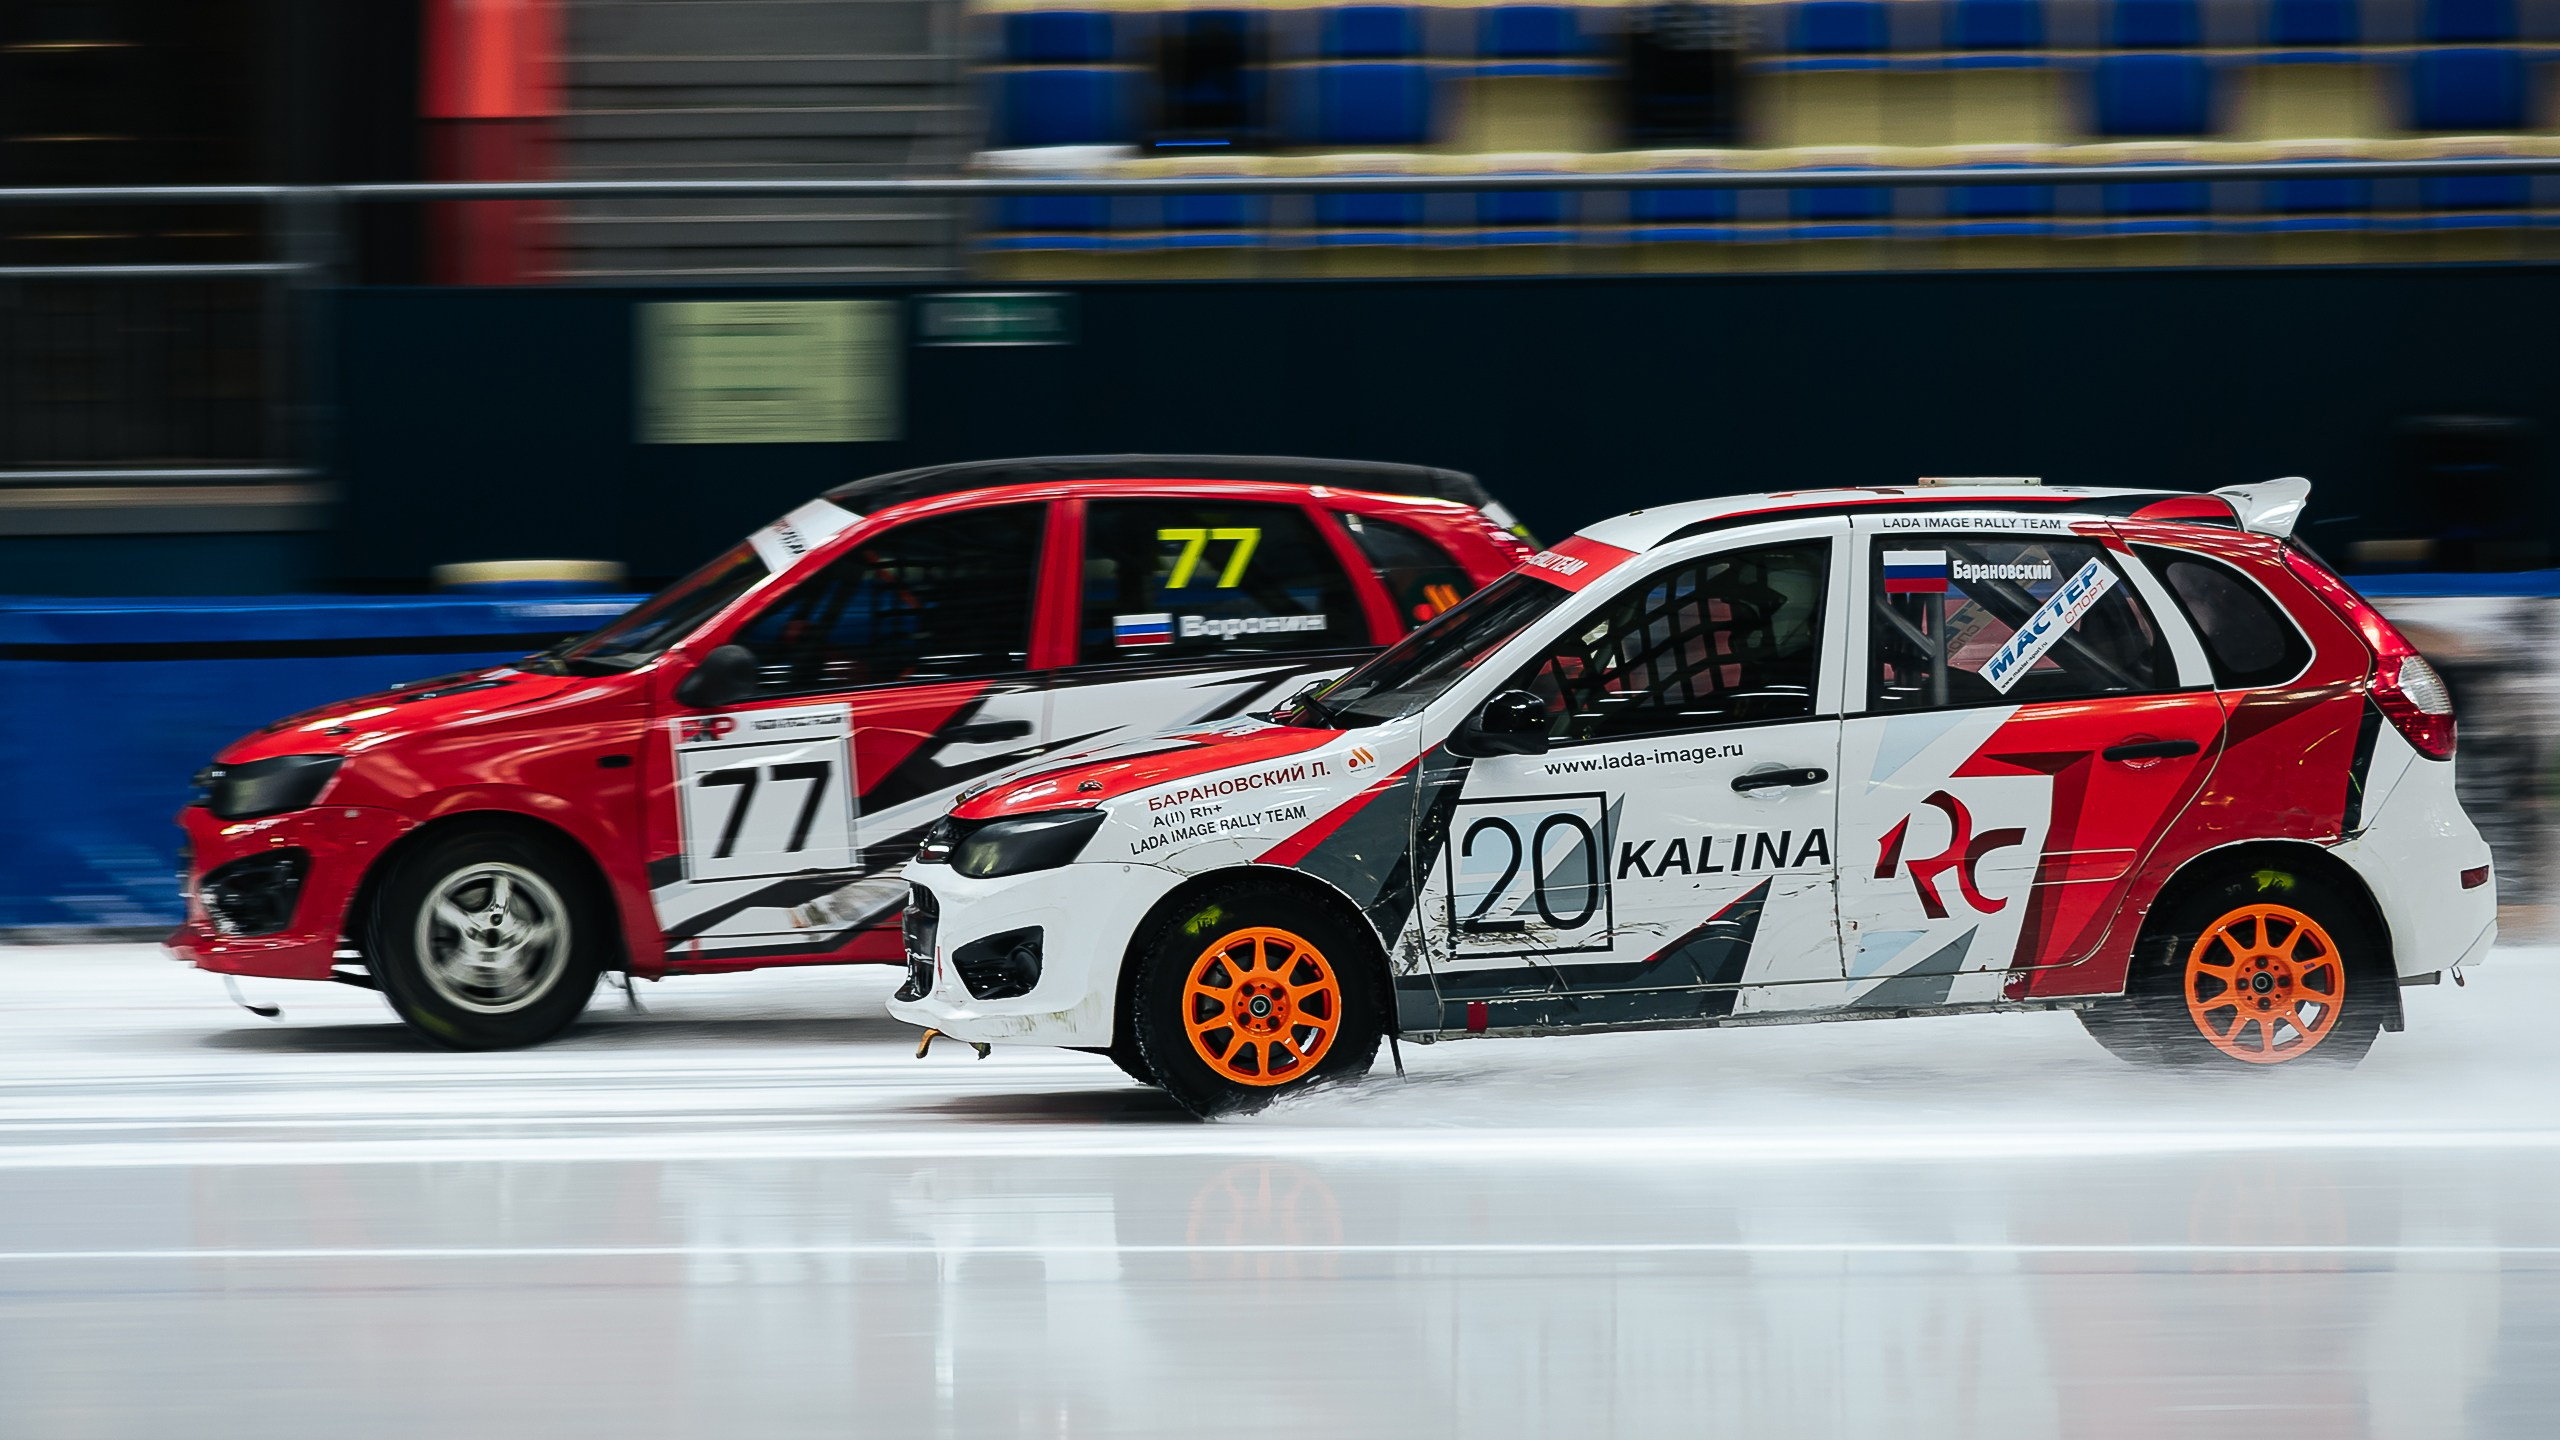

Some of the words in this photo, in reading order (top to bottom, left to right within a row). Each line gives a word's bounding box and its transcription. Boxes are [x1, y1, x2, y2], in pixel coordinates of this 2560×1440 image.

[1882, 518, 1921, 529] LADA
[1924, 518, 1970, 528] IMAGE
[1974, 518, 2017, 529] RALLY
[2020, 518, 2062, 529] TEAM
[1157, 528, 1262, 589] 77
[1952, 559, 2052, 584] Барановский
[1989, 563, 2098, 682] МАСТЕР
[2064, 579, 2106, 625] СПОРТ
[1544, 742, 1745, 776] www.lada-image.ru
[695, 760, 833, 859] 77
[1148, 763, 1306, 812] БАРАНОВСКИЙ
[1311, 761, 1331, 778] Л.
[1190, 804, 1223, 819] Rh+
[1130, 834, 1169, 856] LADA
[1171, 821, 1217, 843] IMAGE
[1220, 812, 1262, 832] RALLY
[1265, 805, 1307, 824] TEAM
[1617, 828, 1832, 880] KALINA
[1461, 812, 1599, 934] 20
